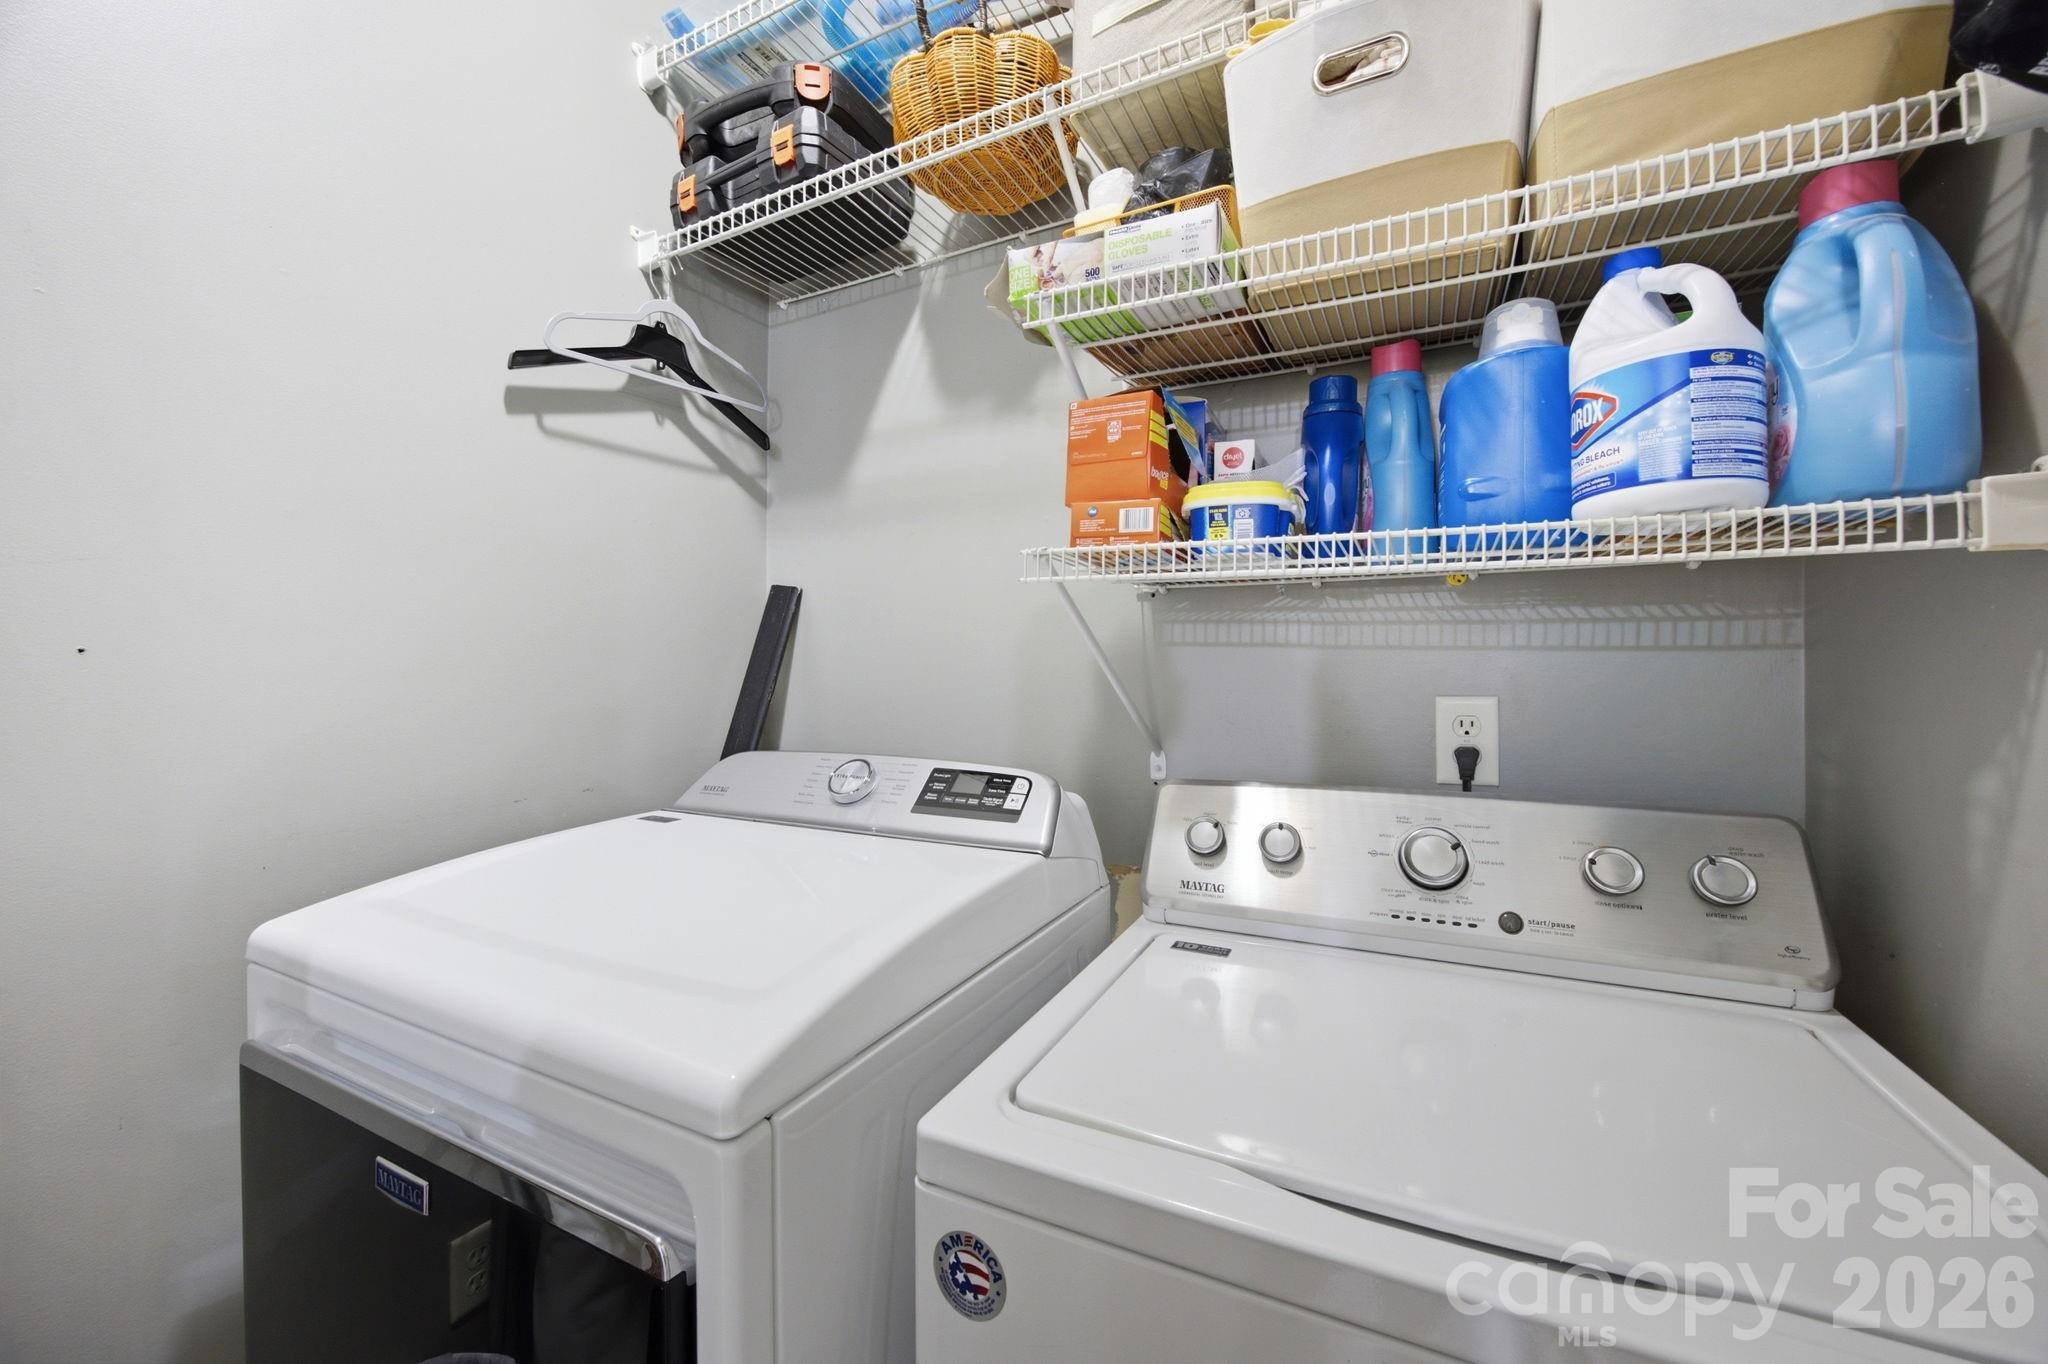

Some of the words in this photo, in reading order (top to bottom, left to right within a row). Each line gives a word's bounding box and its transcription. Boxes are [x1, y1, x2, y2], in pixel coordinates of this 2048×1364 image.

[1108, 228, 1173, 250] DISPOSABLE
[1108, 244, 1149, 260] GLOVES
[1009, 267, 1031, 280] ONE
[1085, 266, 1100, 278] 500
[1585, 446, 1621, 464] BLEACH
[1179, 879, 1225, 894] MAYTAG
[1527, 919, 1576, 930] start/pause
[378, 1167, 422, 1205] MAYTAG
[941, 1233, 1003, 1284] AMERICA
